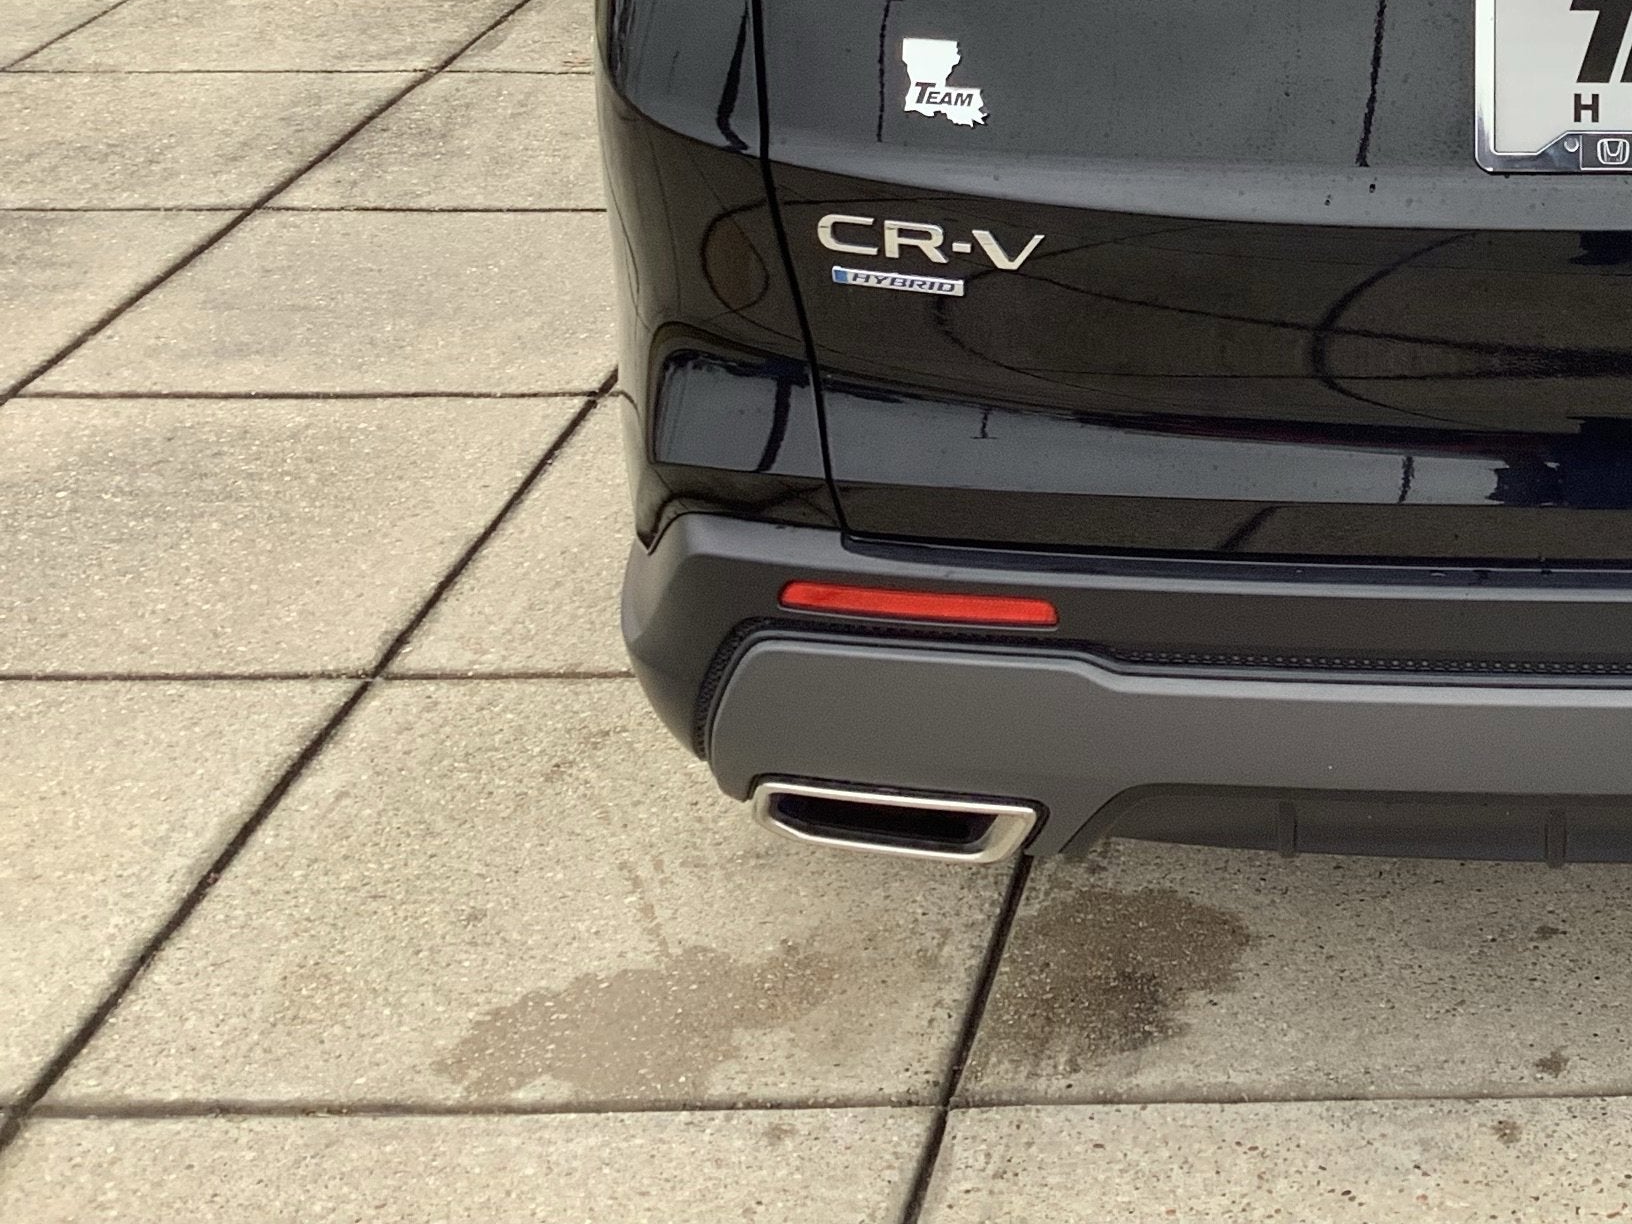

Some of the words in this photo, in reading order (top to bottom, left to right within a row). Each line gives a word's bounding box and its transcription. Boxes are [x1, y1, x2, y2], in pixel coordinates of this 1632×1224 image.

[914, 82, 974, 108] TEAM
[817, 213, 1045, 271] CR-V
[852, 272, 956, 294] HYBRID
